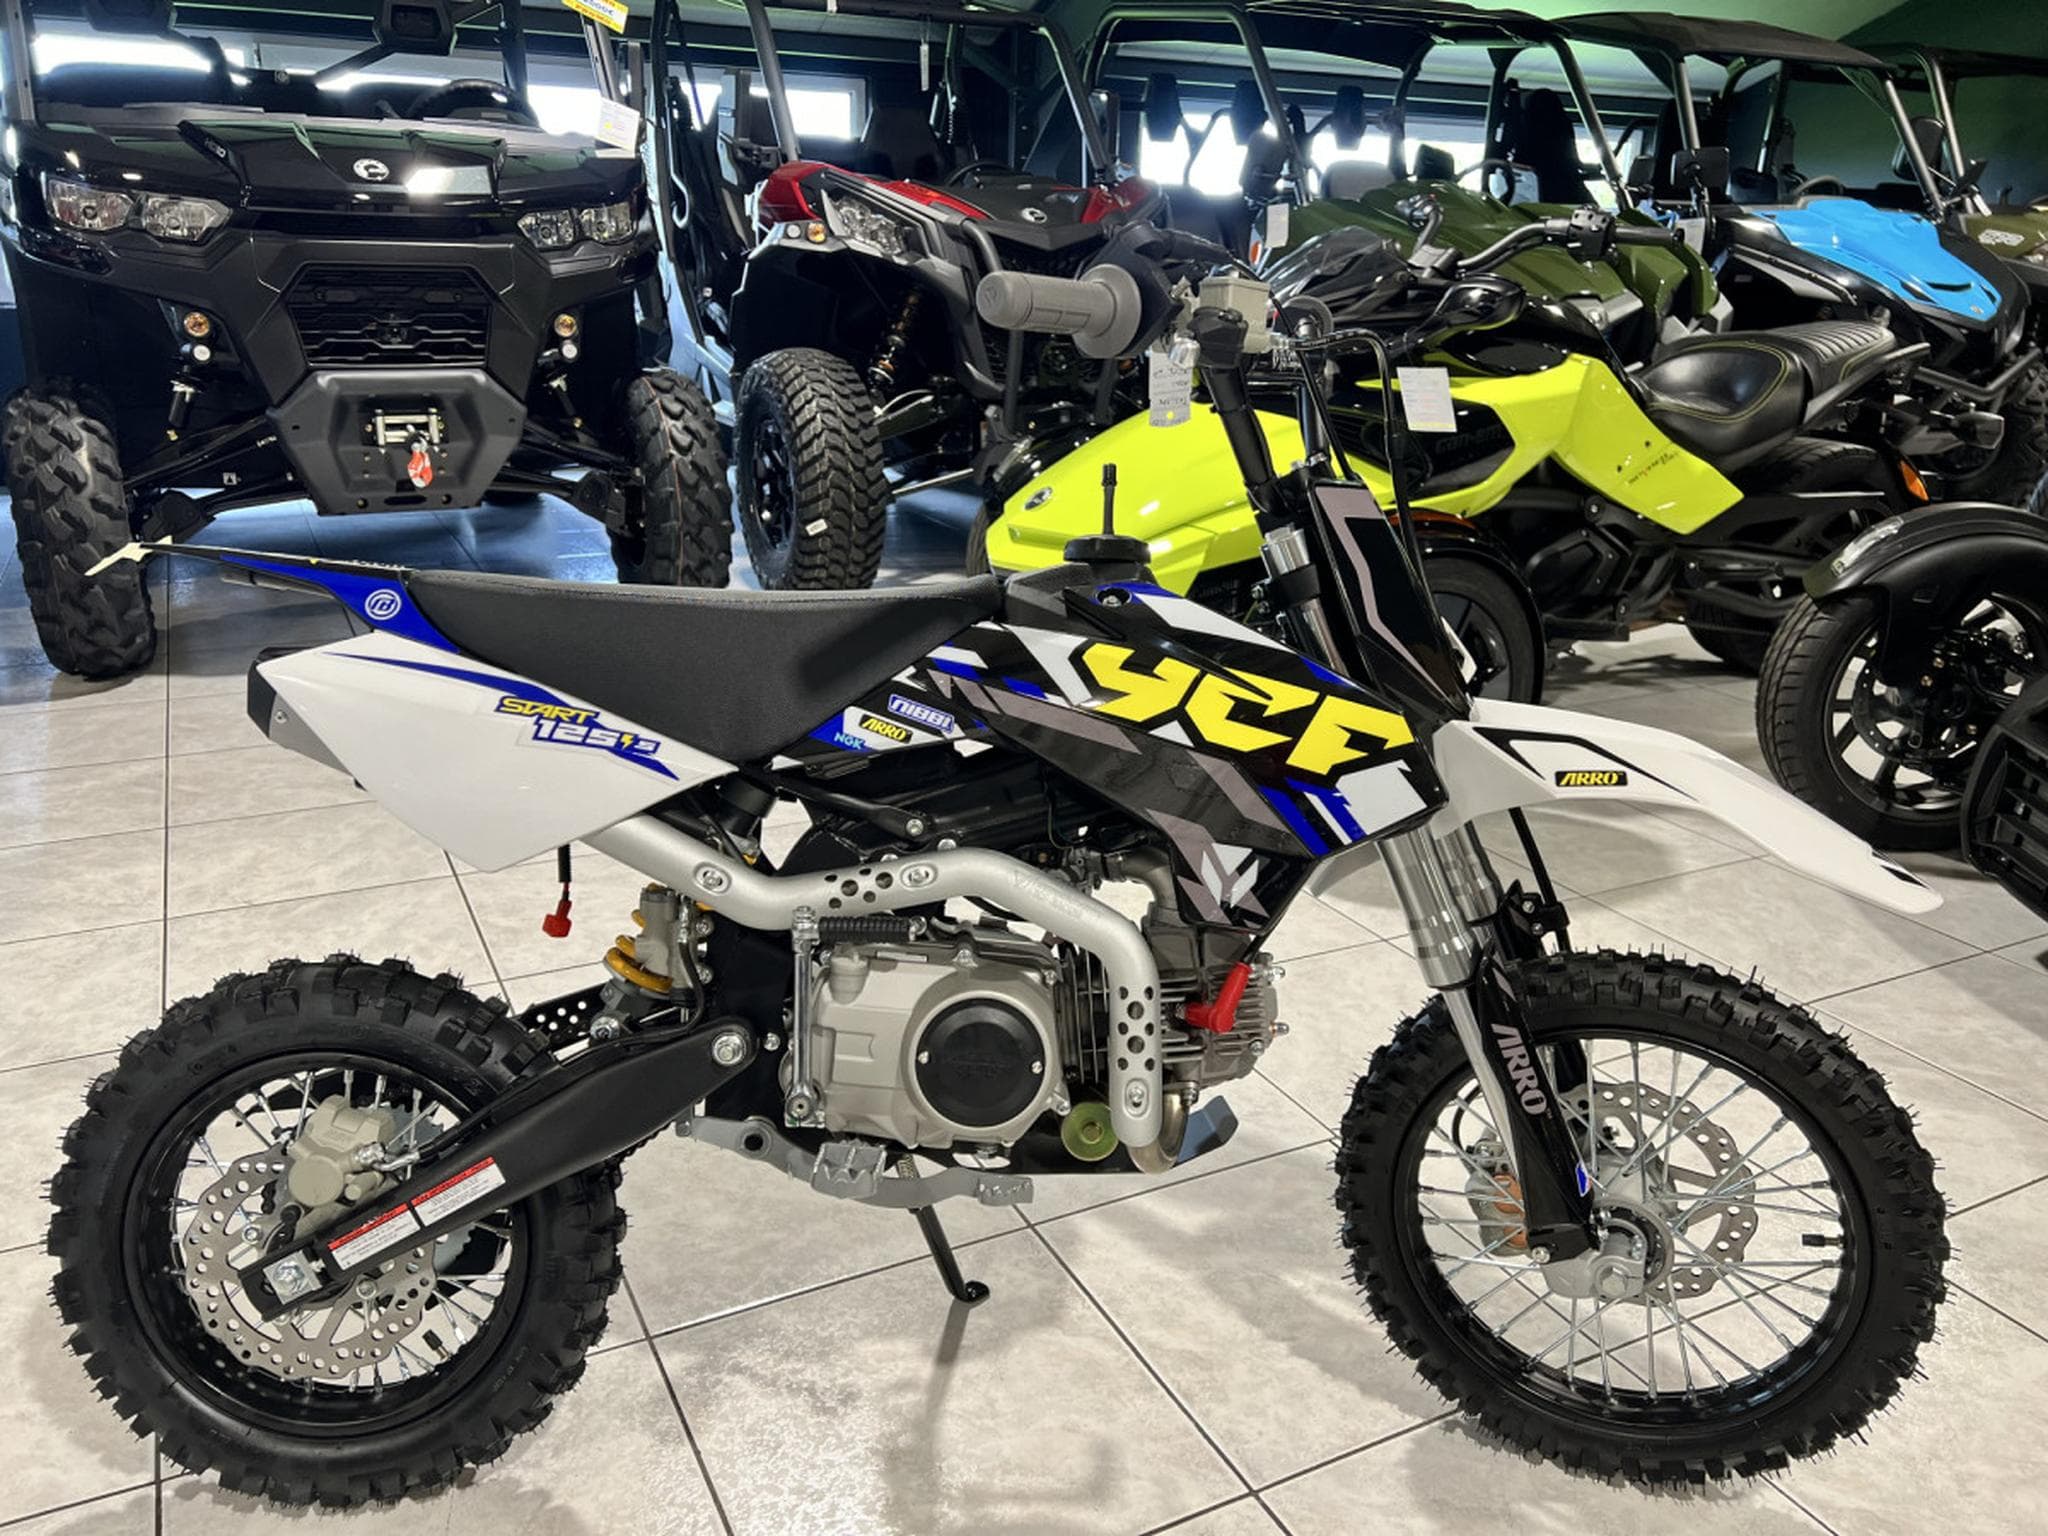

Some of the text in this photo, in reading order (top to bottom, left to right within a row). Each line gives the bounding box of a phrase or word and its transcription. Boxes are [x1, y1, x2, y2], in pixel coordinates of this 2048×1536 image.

[501, 697, 595, 724] START
[890, 699, 953, 728] NIBBI
[1082, 642, 1415, 775] YCF
[535, 718, 621, 747] 125
[834, 732, 864, 749] NGK
[861, 718, 907, 741] ARRO
[1559, 771, 1619, 785] ARRO
[1490, 1023, 1548, 1115] ARRO
